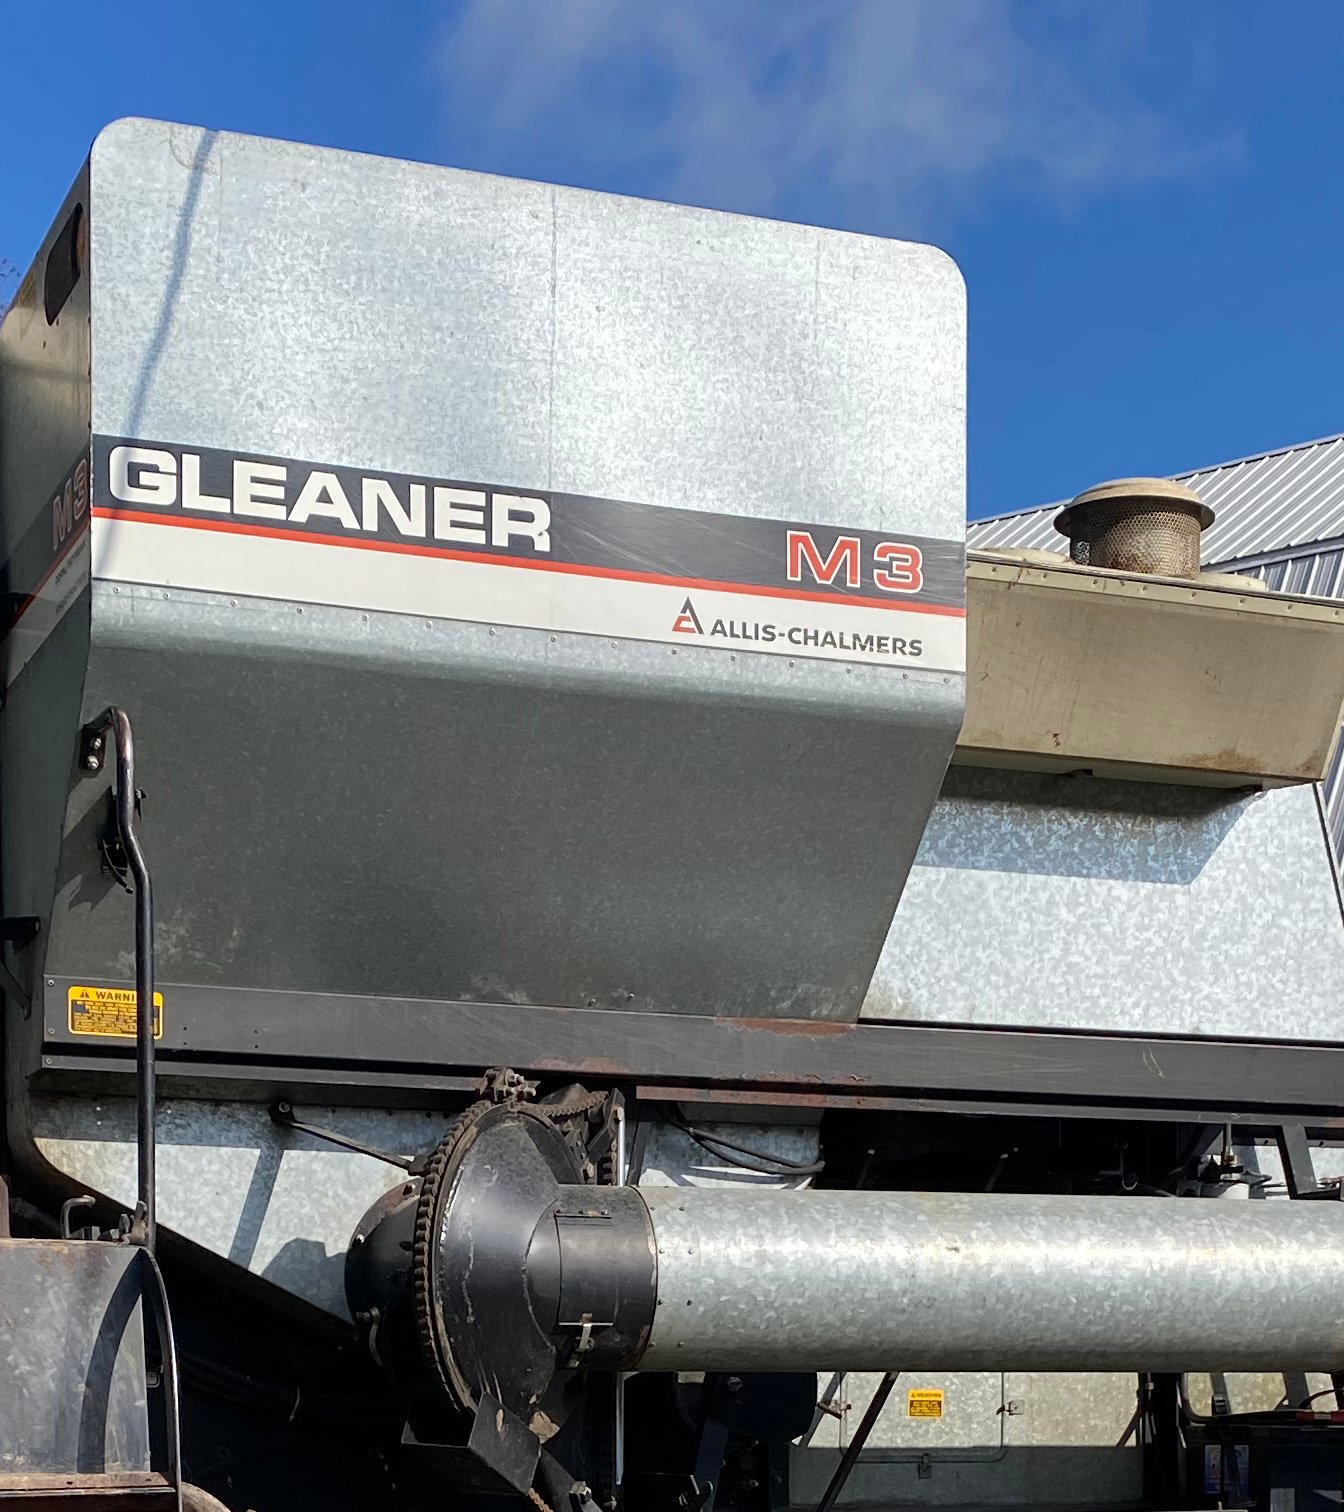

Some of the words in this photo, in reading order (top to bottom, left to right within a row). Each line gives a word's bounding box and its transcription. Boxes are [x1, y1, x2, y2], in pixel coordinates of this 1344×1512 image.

[52, 458, 88, 551] M3
[107, 444, 552, 553] GLEANER
[785, 529, 925, 594] M3
[710, 618, 924, 658] ALLIS-CHALMERS
[96, 990, 136, 1002] WARNI
